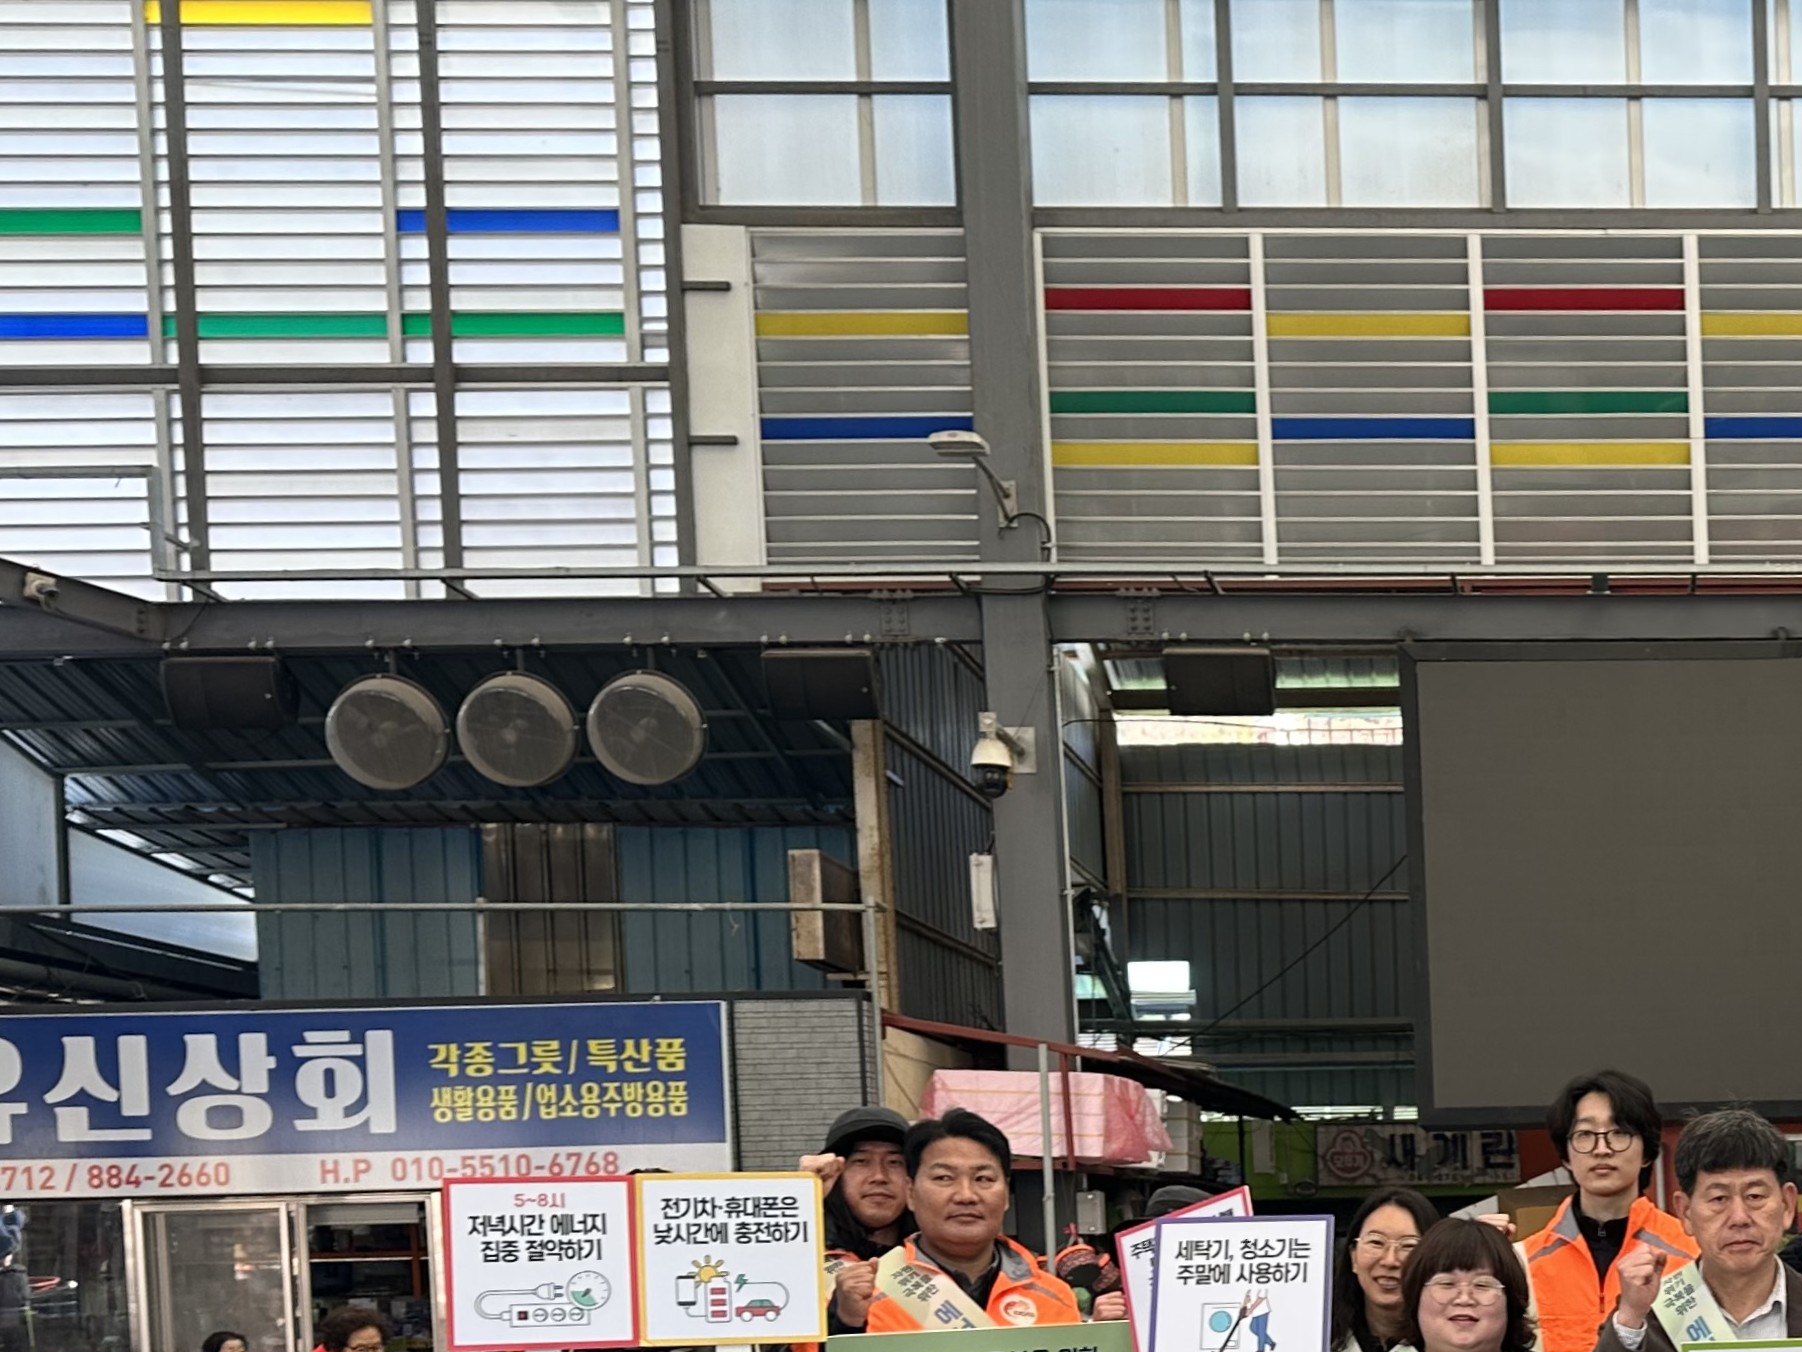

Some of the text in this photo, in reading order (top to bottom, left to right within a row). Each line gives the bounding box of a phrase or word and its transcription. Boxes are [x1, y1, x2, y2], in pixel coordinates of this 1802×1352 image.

[587, 1037, 687, 1074] 특산품
[87, 1161, 231, 1190] 884-2660
[320, 1159, 371, 1184] H.P
[391, 1151, 620, 1183] 010-5510-6768
[515, 1193, 565, 1208] 5~8시
[467, 1212, 607, 1237] 저녁시간 에너지
[653, 1220, 809, 1246] 낮시간에 충전하기
[480, 1238, 603, 1264] 집중 절약하기
[1174, 1239, 1235, 1262] 세탁기,
[1239, 1237, 1312, 1260] 청소기는
[1176, 1264, 1231, 1286] 주말에
[1235, 1262, 1309, 1285] 사용하기
